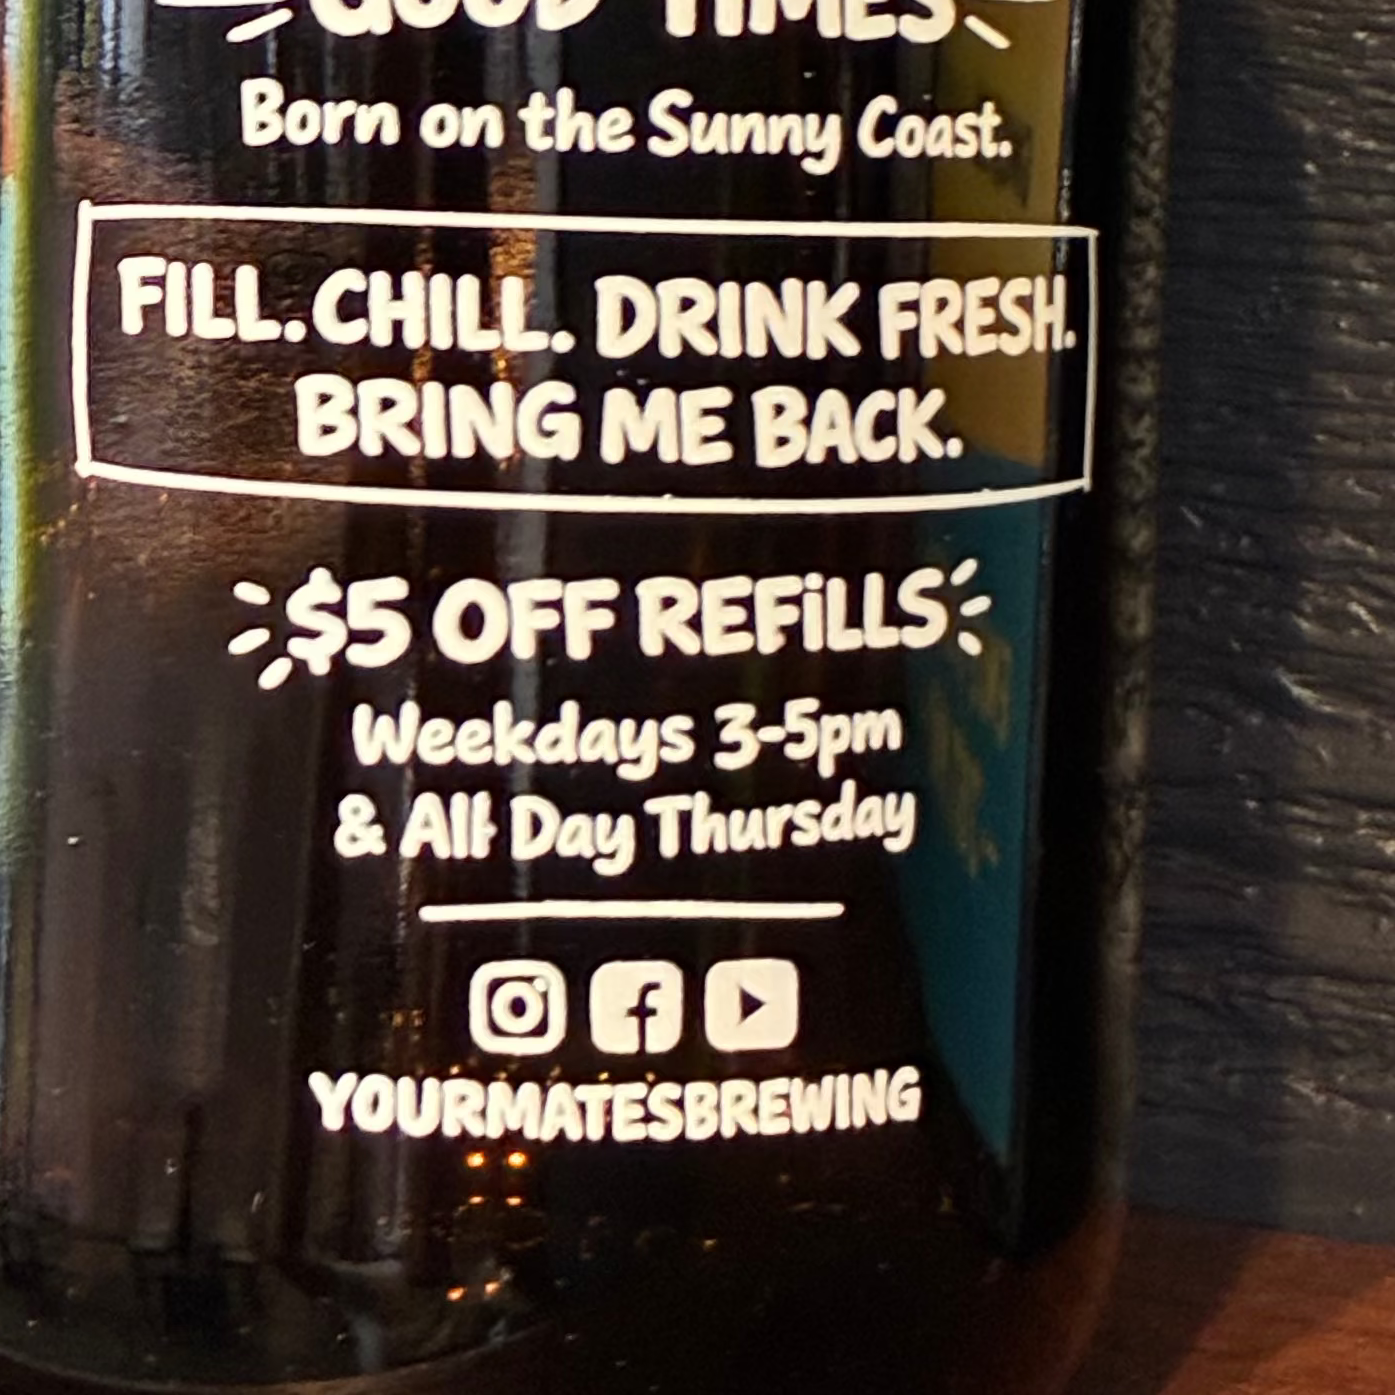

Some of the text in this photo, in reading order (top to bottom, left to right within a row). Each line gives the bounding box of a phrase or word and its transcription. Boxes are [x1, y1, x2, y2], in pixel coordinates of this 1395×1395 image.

[240, 77, 1012, 176] Born on the Sunny Coast.
[117, 256, 1076, 360] FILL. CHILL. DRINK FRESH.
[294, 373, 962, 468] BRING ME BACK.
[285, 567, 410, 674] $5
[432, 578, 620, 664] OFF
[352, 697, 901, 781] Weekdays 3-5pm
[333, 779, 915, 876] & All Day Thursday
[308, 1066, 921, 1142] YOURMATESBREWING
